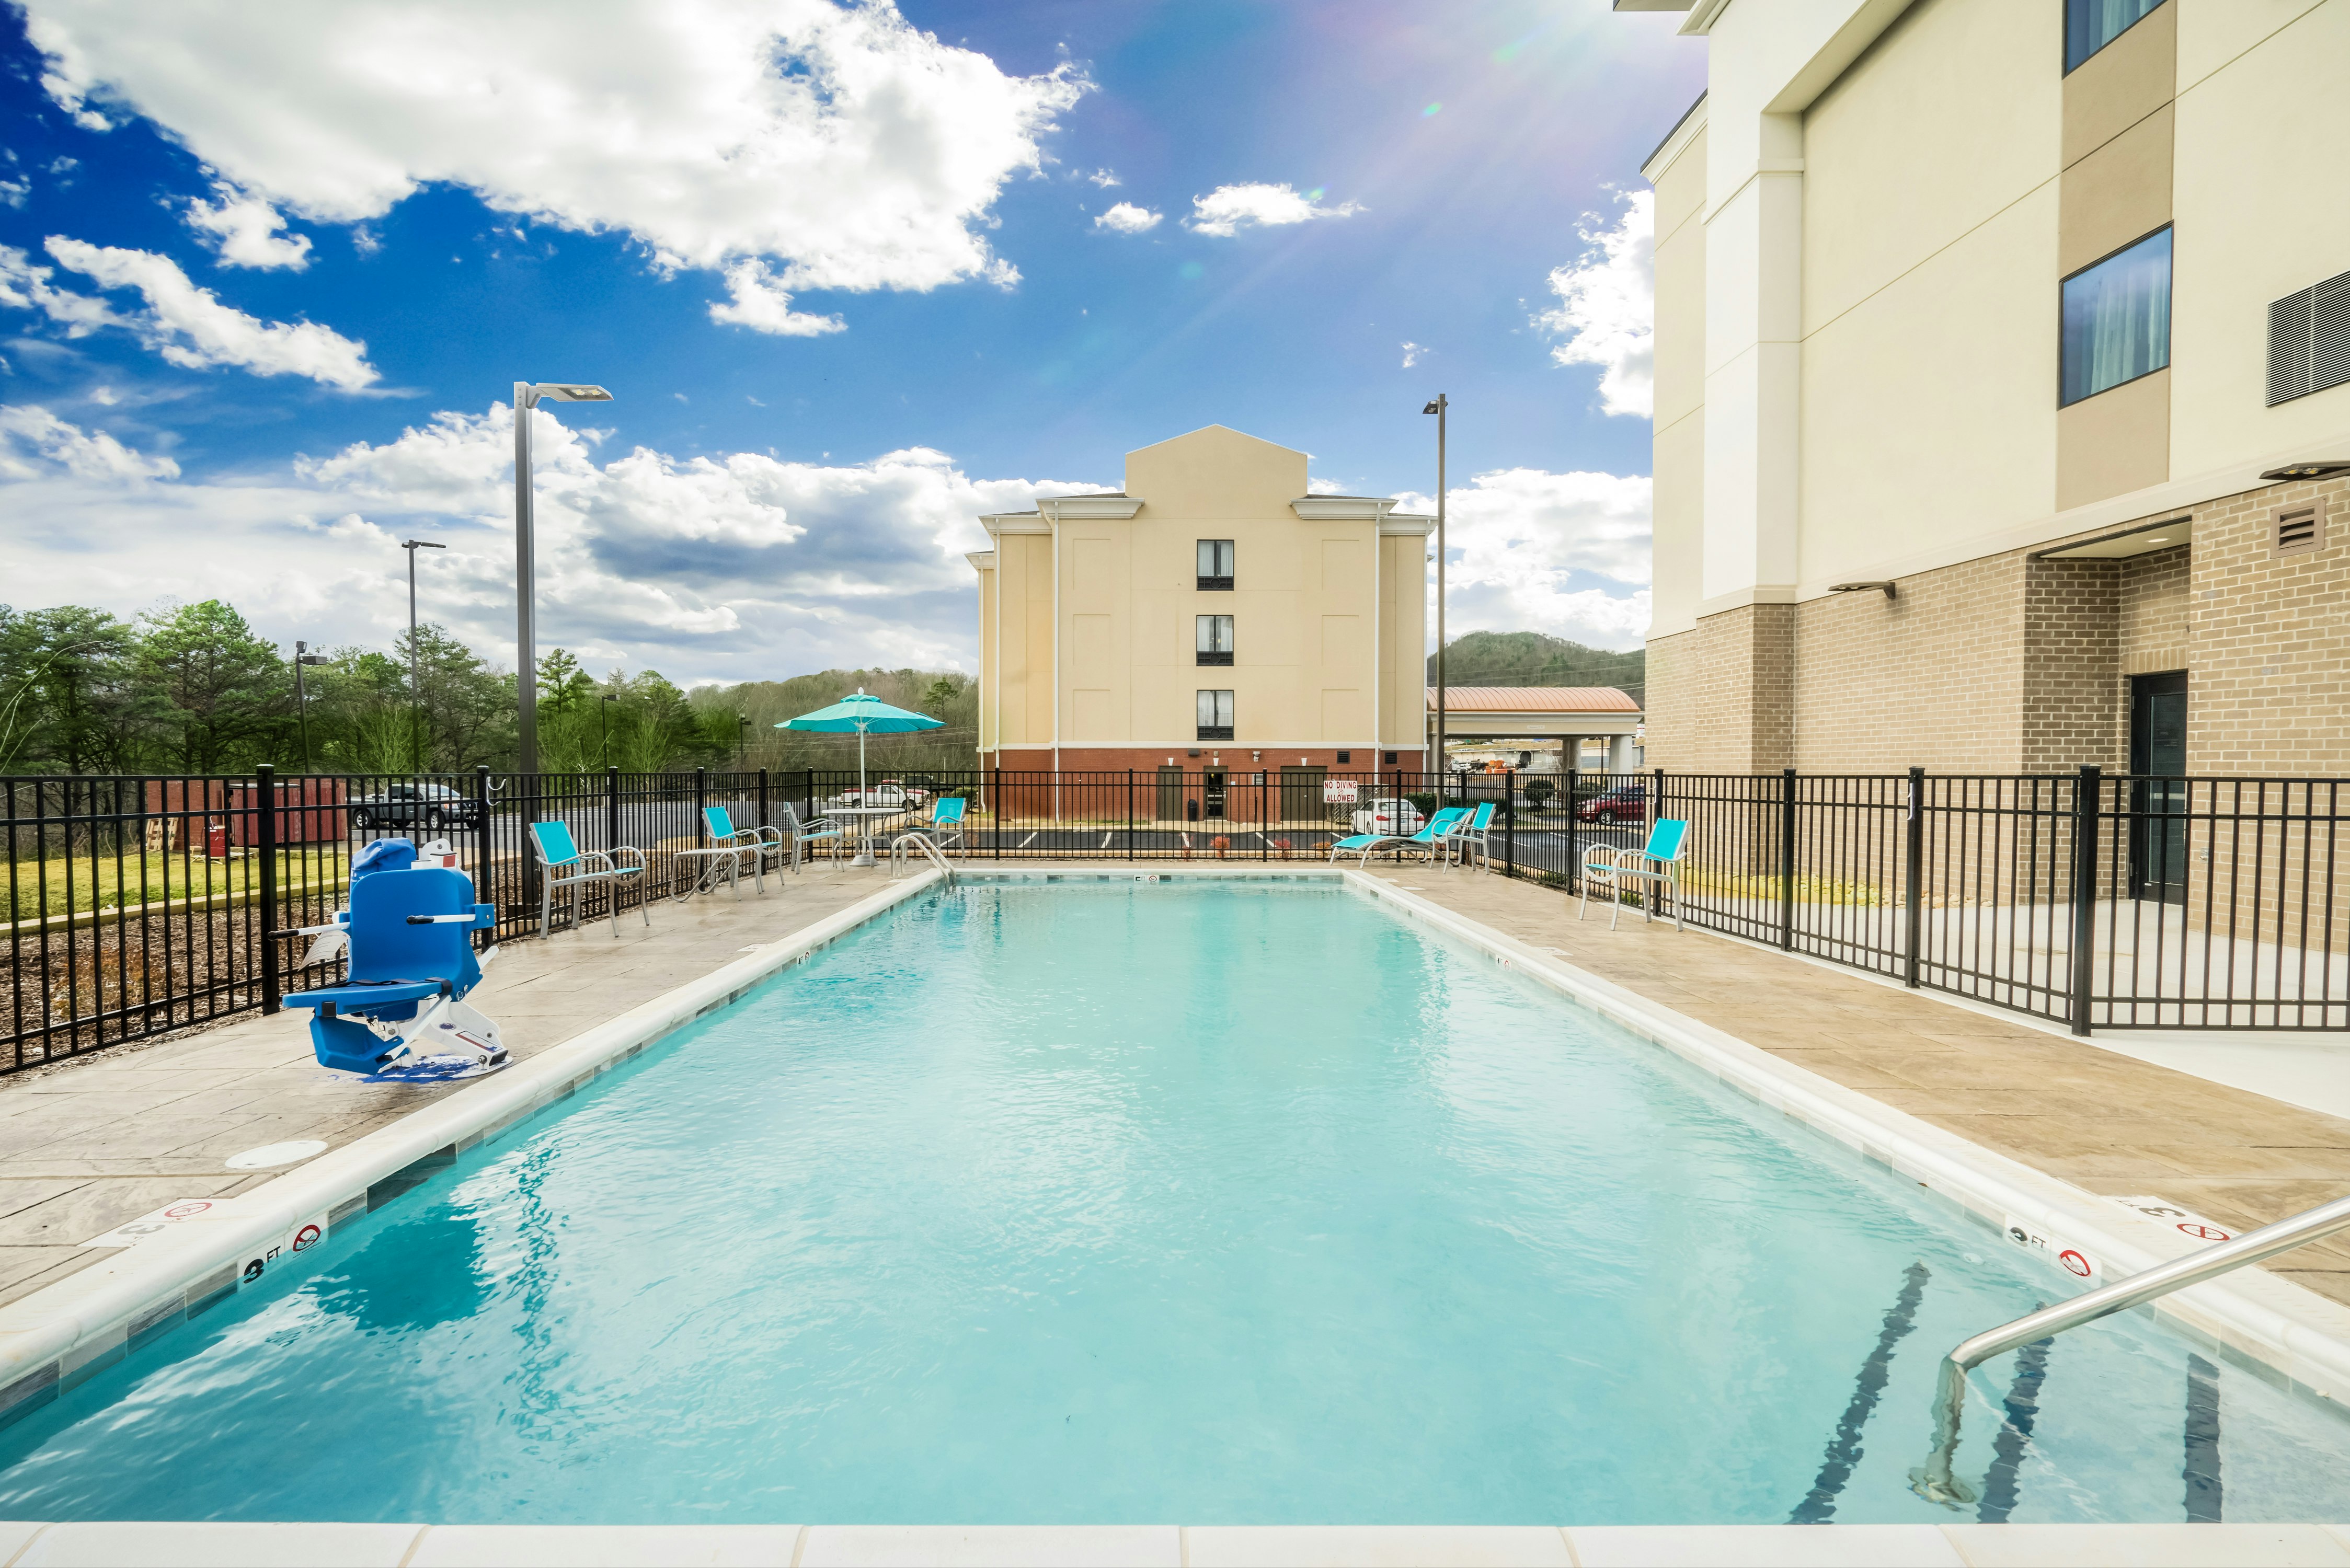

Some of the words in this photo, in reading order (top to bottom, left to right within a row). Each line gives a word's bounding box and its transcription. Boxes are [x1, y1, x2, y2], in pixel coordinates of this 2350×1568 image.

[2032, 1235, 2046, 1248] FT
[243, 1259, 265, 1284] 3
[267, 1246, 281, 1263] FT
